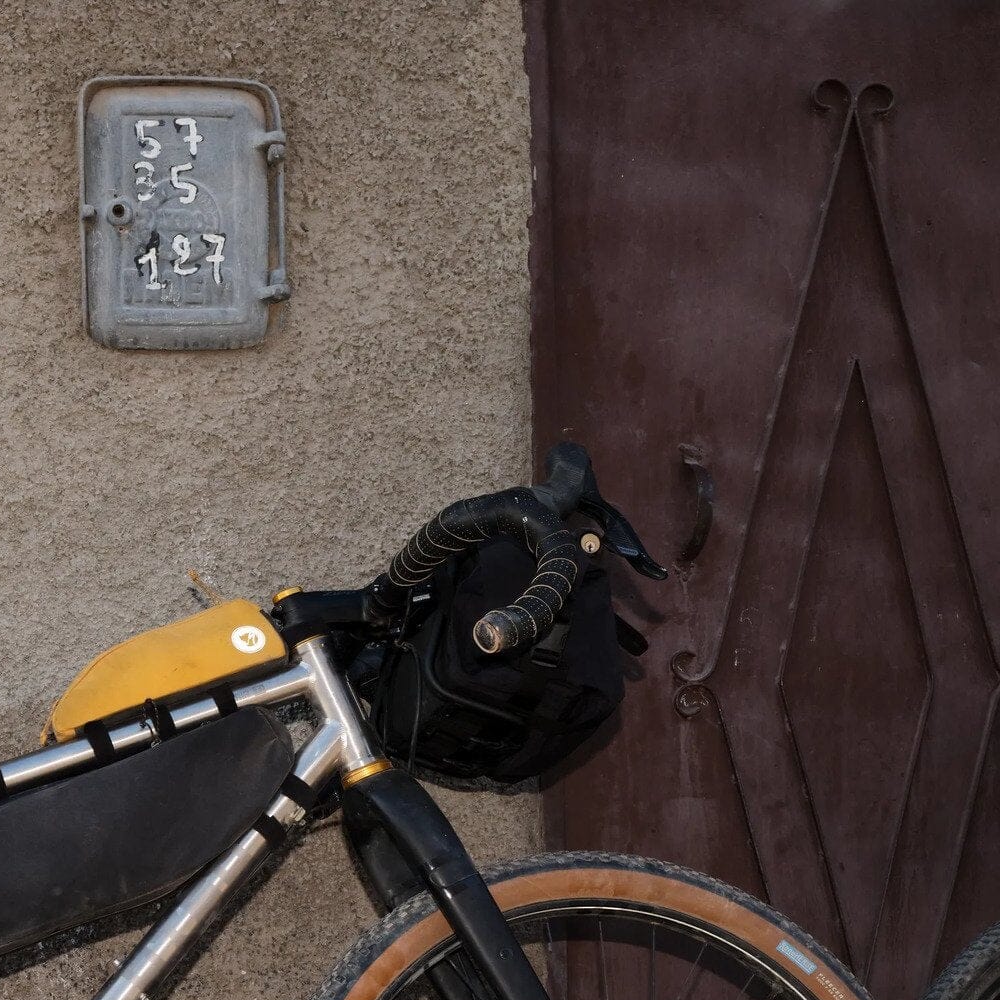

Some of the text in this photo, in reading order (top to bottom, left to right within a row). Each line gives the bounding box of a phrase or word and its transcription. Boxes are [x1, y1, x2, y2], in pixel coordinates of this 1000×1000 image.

[134, 117, 204, 159] 57
[133, 162, 198, 204] 35
[134, 232, 226, 290] 127
